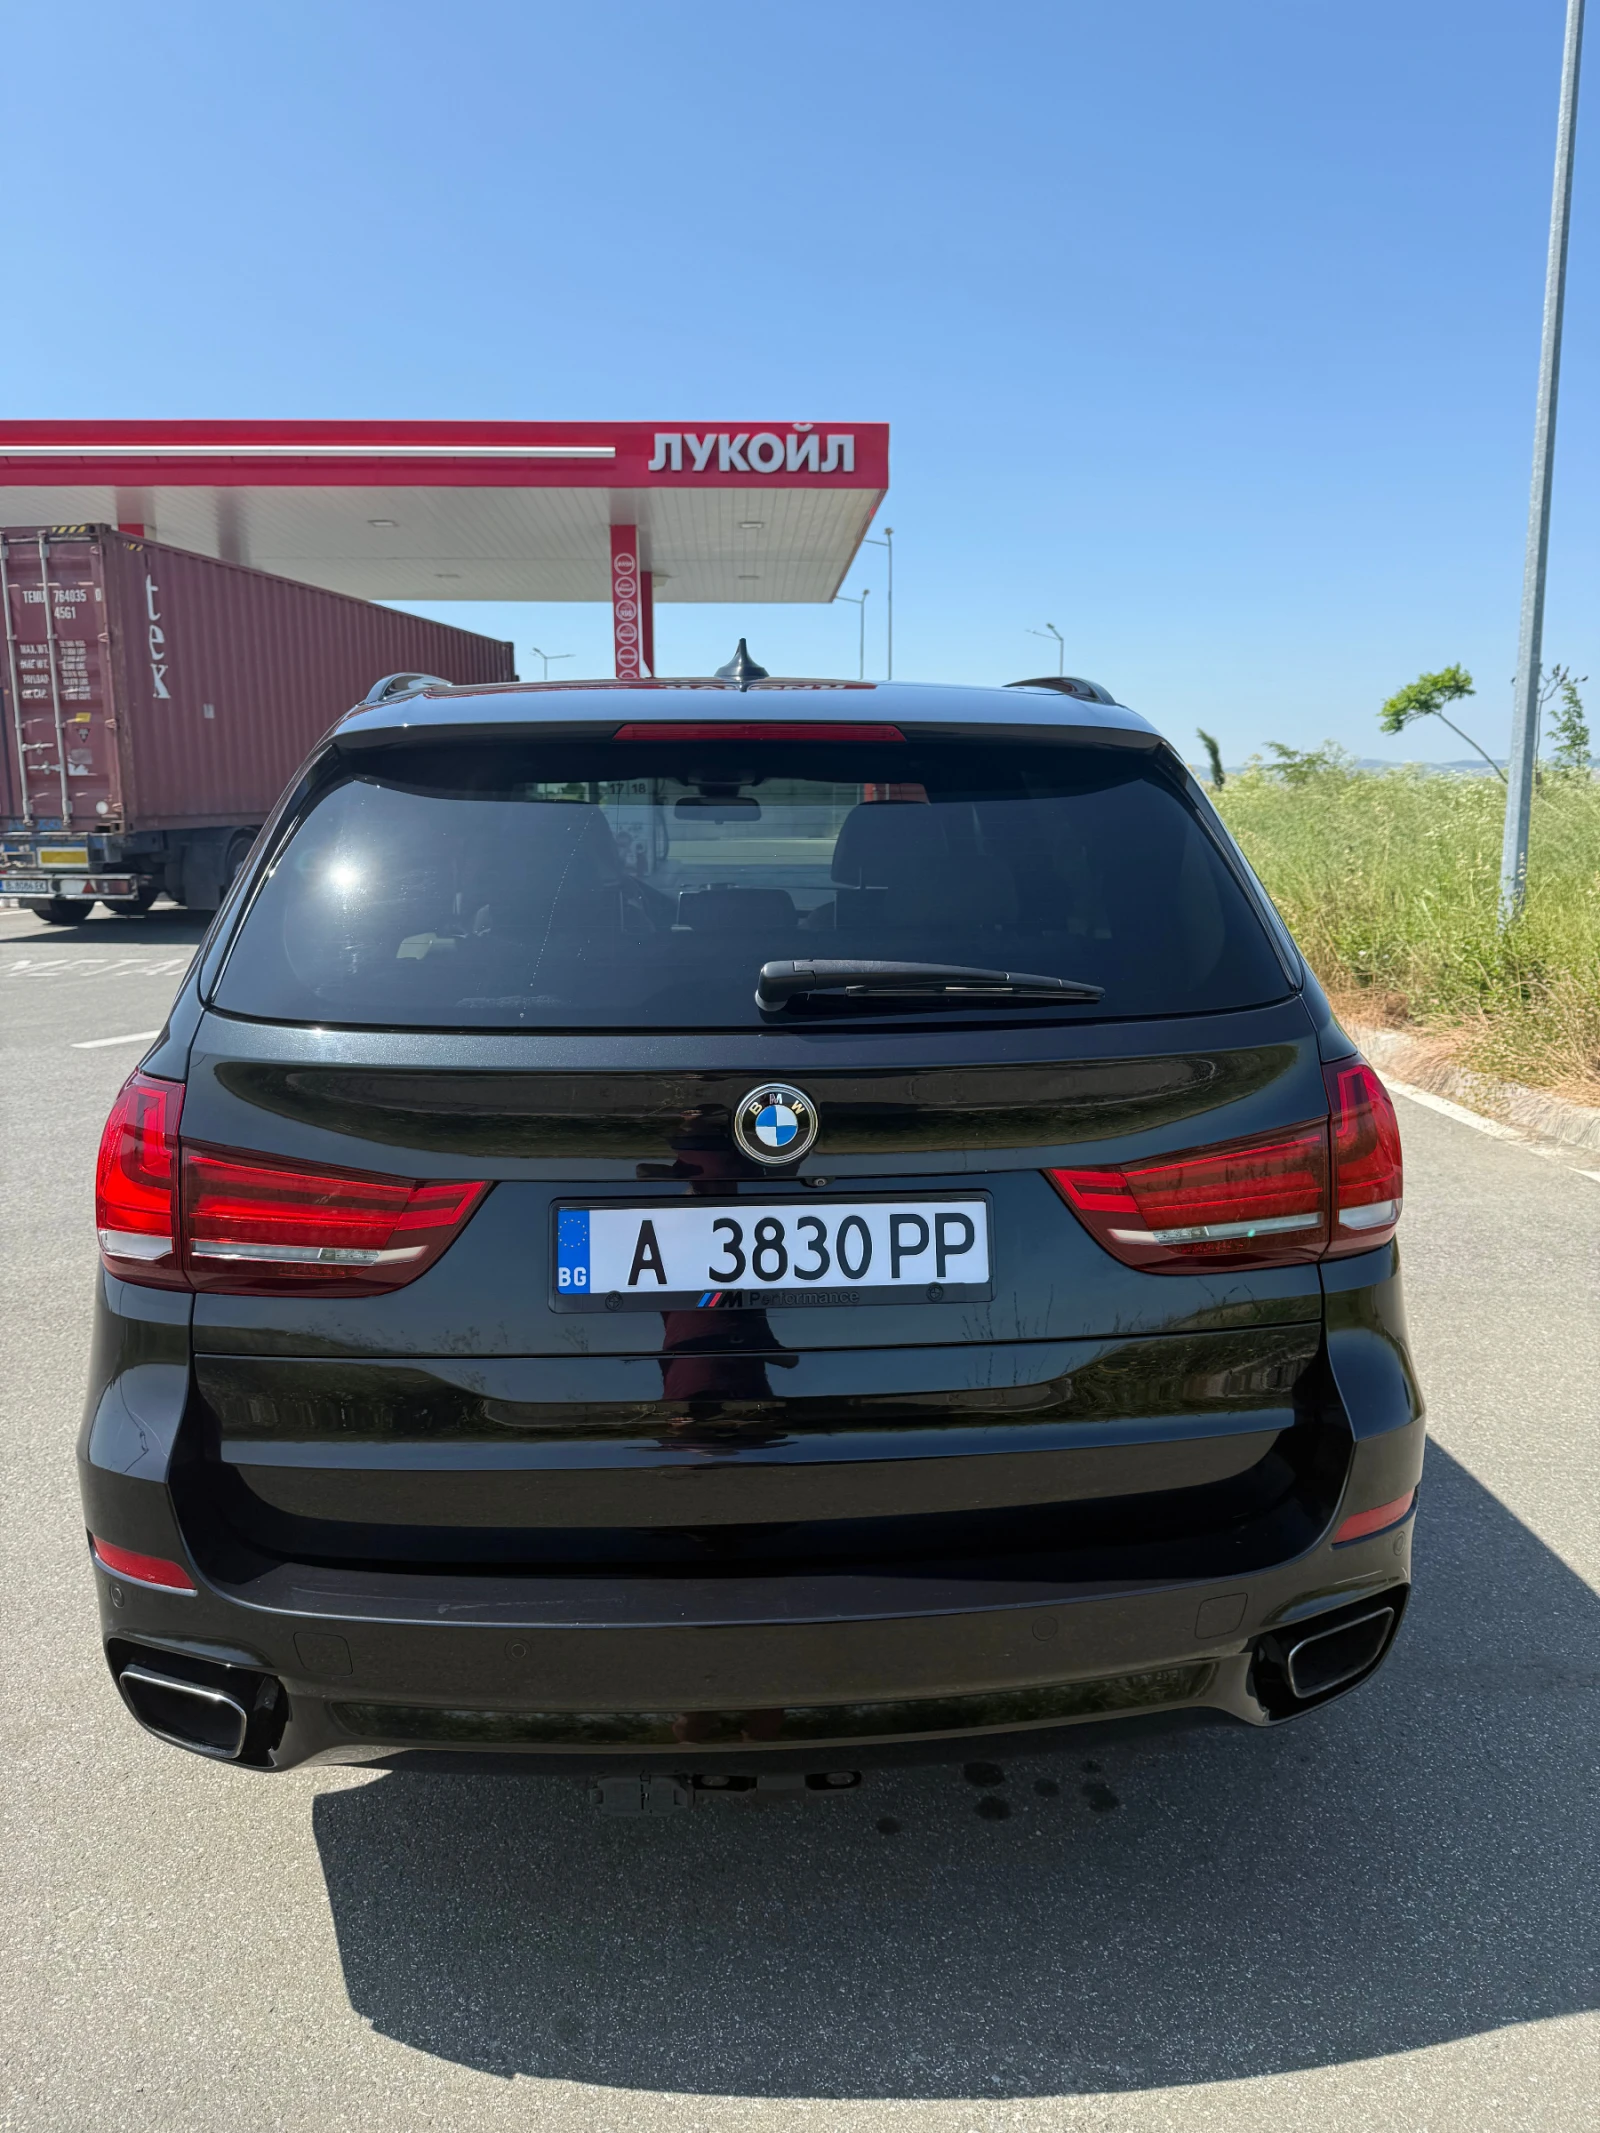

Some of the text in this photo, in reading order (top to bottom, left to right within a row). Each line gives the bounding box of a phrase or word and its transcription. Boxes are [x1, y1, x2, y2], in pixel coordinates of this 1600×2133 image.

[648, 423, 855, 473] ЛУКОЙЛ
[53, 589, 87, 602] 764035
[54, 607, 76, 619] 45G1
[145, 574, 171, 699] tex
[610, 783, 646, 794] 17 18
[749, 1093, 805, 1116] BMW
[558, 1212, 976, 1286] BG A 3830 PP
[750, 1291, 860, 1306] Performance
